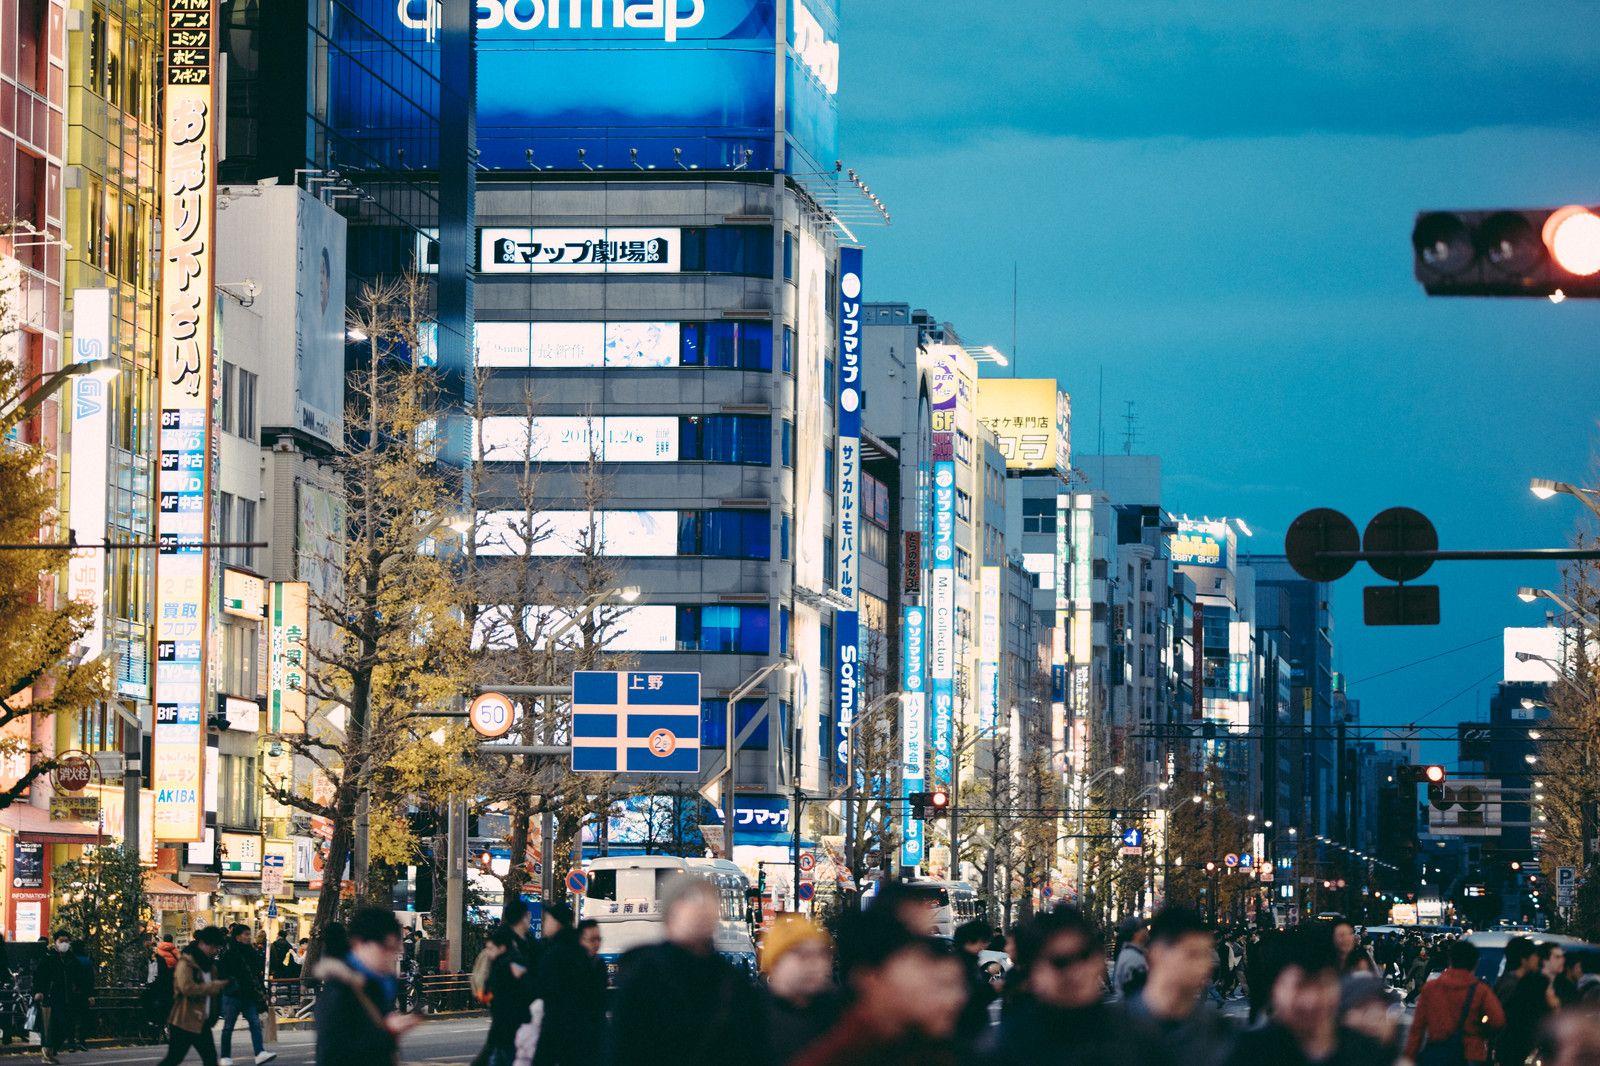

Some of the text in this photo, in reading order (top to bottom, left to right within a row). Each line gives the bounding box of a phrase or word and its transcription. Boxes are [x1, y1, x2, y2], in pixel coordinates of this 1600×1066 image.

[171, 13, 209, 27] アニメ
[172, 31, 207, 46] コミック
[172, 50, 206, 65] ホビー
[171, 68, 207, 83] フィギュア
[516, 239, 647, 263] マップ劇場
[842, 302, 859, 383] ソフマップ
[77, 337, 103, 420] SGA
[932, 410, 955, 431] 6F
[179, 453, 203, 468] 中古
[161, 495, 178, 509] 4F
[937, 489, 952, 541] ソフマップ
[908, 533, 918, 579] とらのあな
[163, 602, 198, 618] 買取
[163, 622, 198, 636] フロア
[937, 607, 948, 671] Collection
[159, 644, 175, 657] 1F
[629, 675, 664, 690] 上野
[837, 645, 857, 737] Sofmap
[158, 707, 178, 720] B1F
[481, 705, 504, 724] 50
[59, 767, 90, 781] 消火栓
[157, 788, 197, 803] AKIBA
[1560, 869, 1572, 885] P
